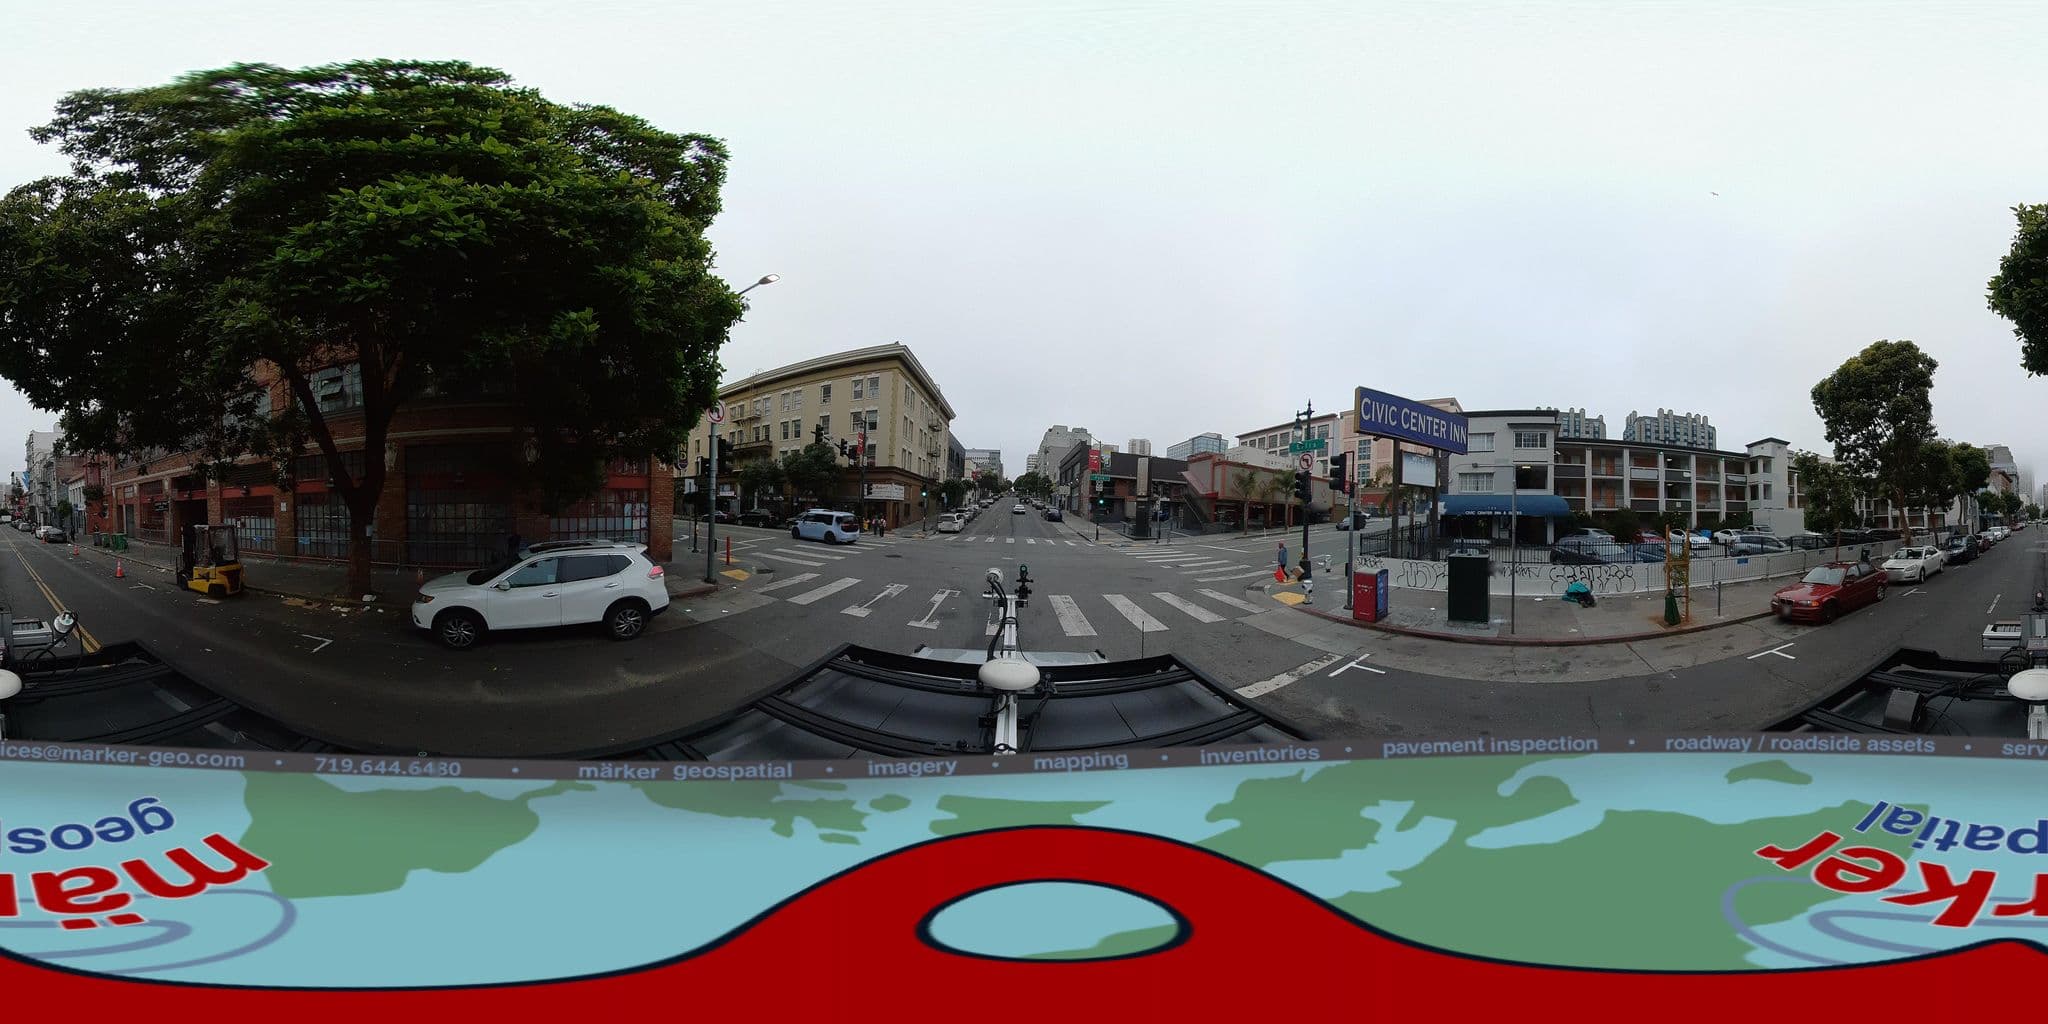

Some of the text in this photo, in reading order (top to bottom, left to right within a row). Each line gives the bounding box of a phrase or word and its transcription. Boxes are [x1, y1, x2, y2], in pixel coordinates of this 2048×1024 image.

[1361, 397, 1467, 445] CIVIC CENTER INN
